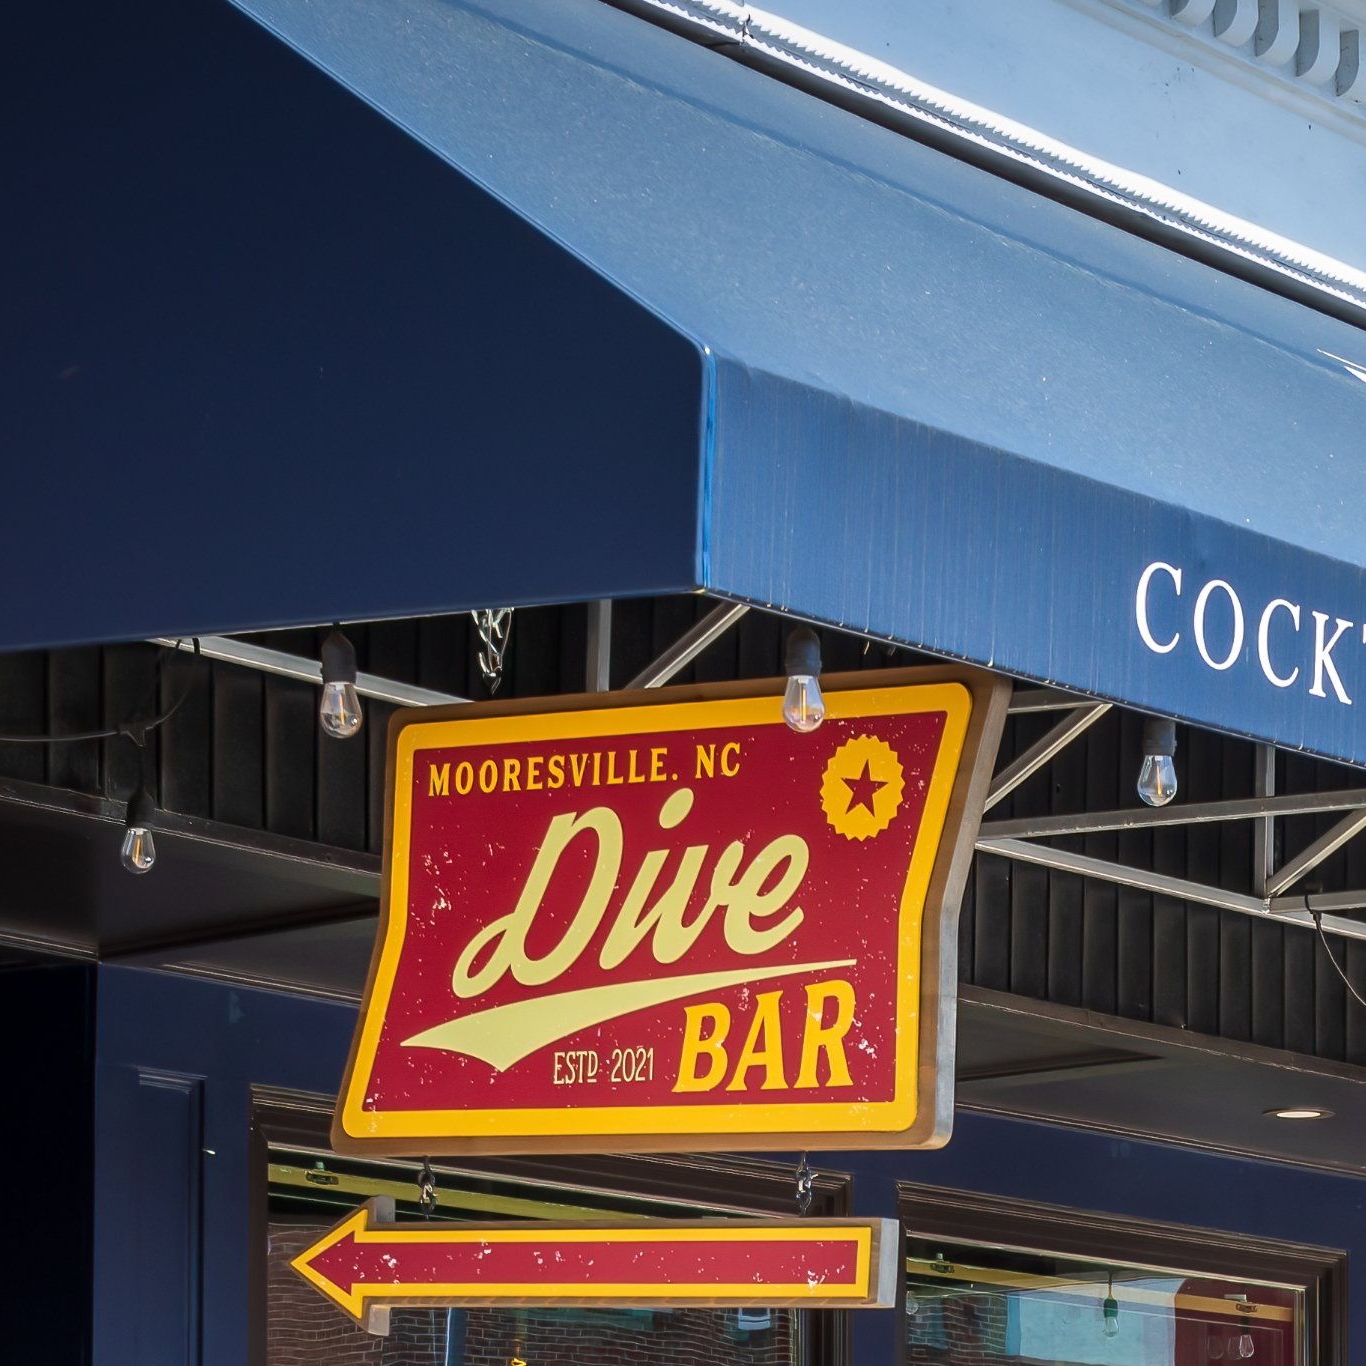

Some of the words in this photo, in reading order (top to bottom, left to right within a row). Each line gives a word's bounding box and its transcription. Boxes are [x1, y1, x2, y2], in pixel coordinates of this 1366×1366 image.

[695, 742, 741, 780] NC
[451, 787, 810, 999] Dive
[552, 1049, 601, 1086] ESTD
[609, 1046, 655, 1084] 2021
[671, 979, 857, 1095] BAR
